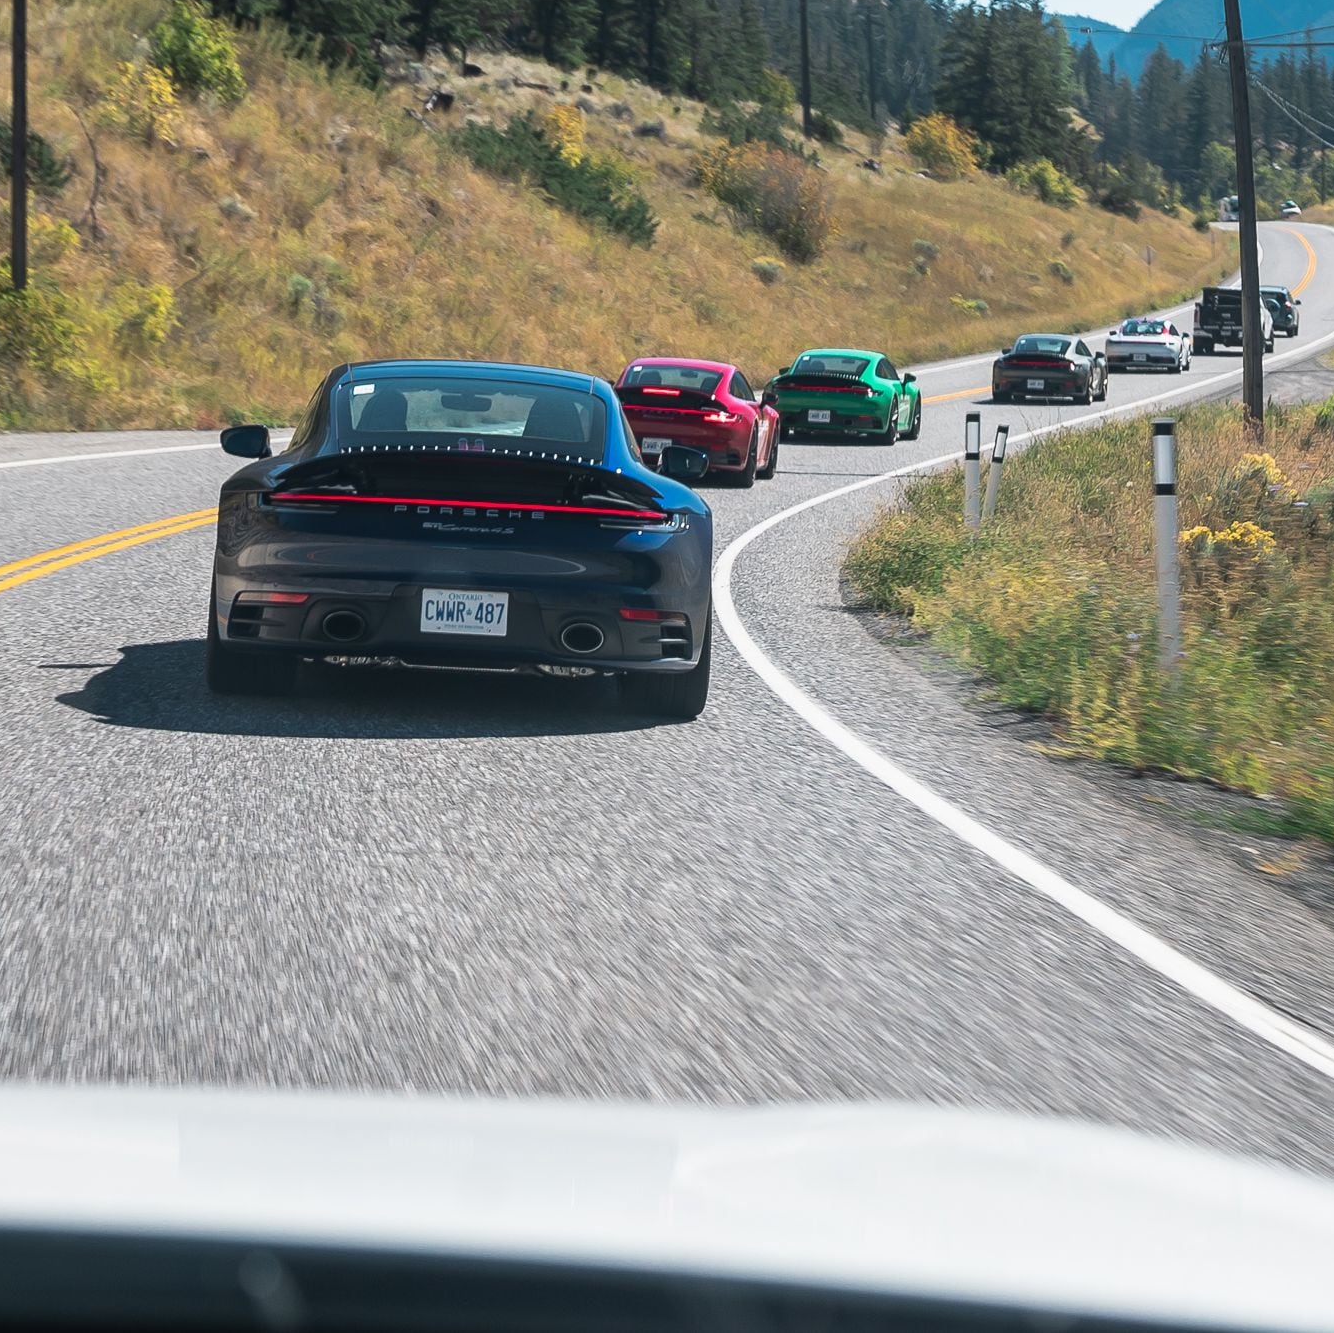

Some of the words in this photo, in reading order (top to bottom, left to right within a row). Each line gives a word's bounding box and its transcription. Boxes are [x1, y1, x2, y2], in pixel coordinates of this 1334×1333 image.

[394, 504, 545, 519] PORSCHE
[448, 592, 483, 601] ONTARIO
[425, 599, 466, 623] CWWR
[474, 602, 505, 625] 487
